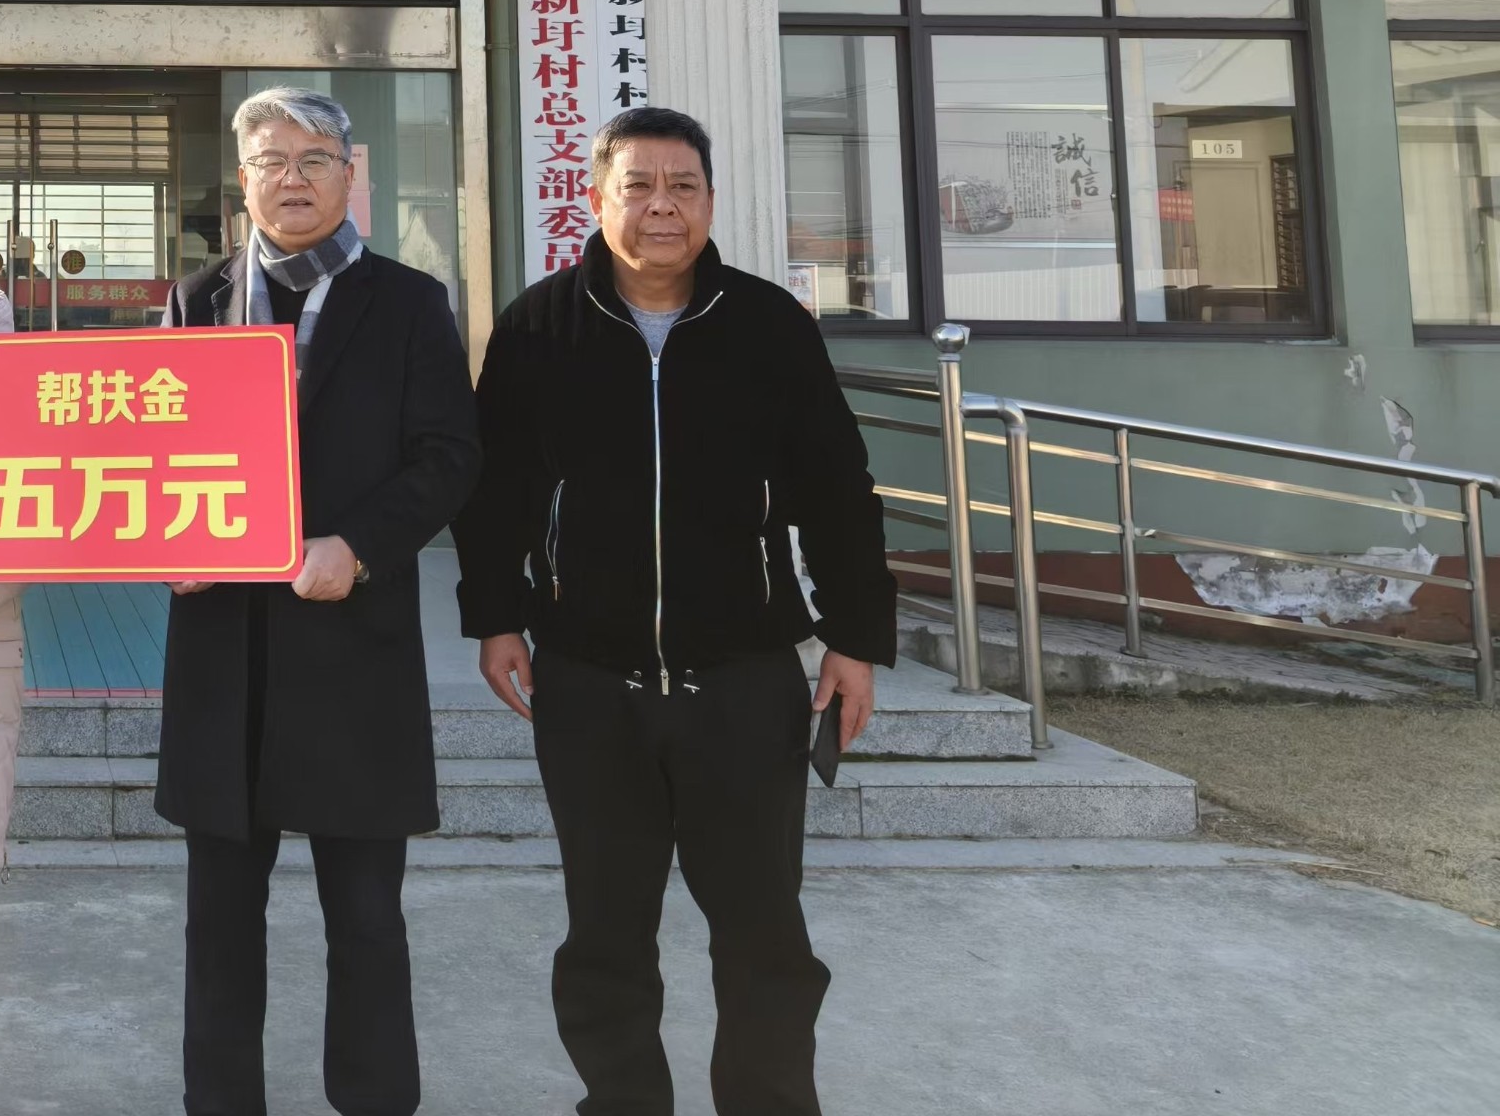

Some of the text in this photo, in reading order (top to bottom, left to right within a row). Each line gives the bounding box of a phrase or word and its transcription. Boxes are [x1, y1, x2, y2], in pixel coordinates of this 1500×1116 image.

[1202, 143, 1235, 155] 105
[66, 285, 149, 301] 服务群众
[36, 367, 189, 426] 帮扶金
